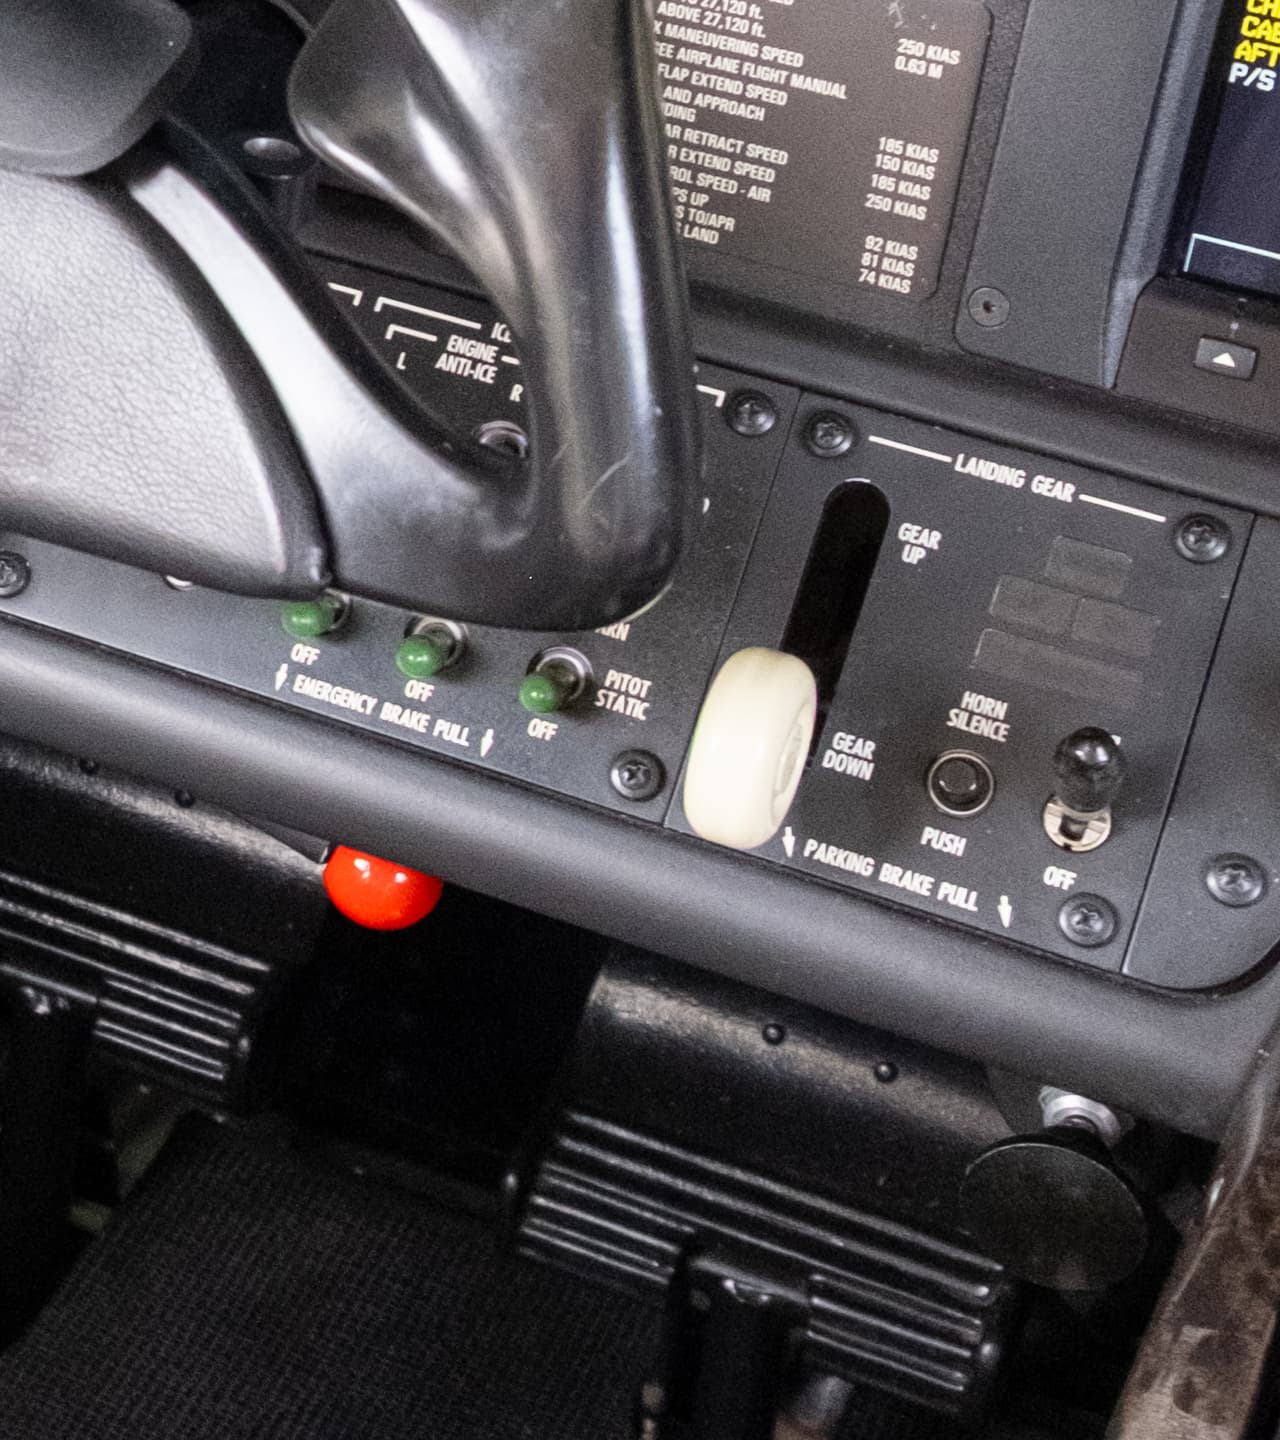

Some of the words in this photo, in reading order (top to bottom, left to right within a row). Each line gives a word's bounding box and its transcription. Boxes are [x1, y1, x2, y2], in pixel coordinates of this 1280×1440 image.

[657, 1, 701, 24] ABOVE
[897, 38, 924, 56] 250
[928, 46, 960, 64] KIAS
[895, 56, 926, 75] 0.63
[928, 64, 943, 79] M
[1227, 62, 1278, 93] P/S
[879, 137, 905, 155] 185
[907, 144, 939, 163] KIAS
[865, 235, 882, 251] 92
[885, 241, 918, 261] KIAS
[858, 269, 876, 284] 74
[878, 274, 911, 294] KIAS
[446, 334, 497, 364] ENGINE
[435, 353, 499, 384] ANTI-ICE
[954, 453, 1025, 491] LANDING
[1030, 475, 1076, 503] GEAR
[897, 522, 942, 551] GEAR
[902, 544, 927, 566] UP
[290, 643, 320, 666] OFF
[604, 669, 652, 699] PITOT
[293, 675, 377, 716] EMERGENCY
[380, 701, 428, 732] BRAKE
[432, 718, 470, 747] PULL
[596, 689, 651, 720] STATIC
[961, 690, 1009, 720] HORN
[946, 708, 1011, 743] SILENCE
[831, 731, 877, 760] GEAR
[822, 750, 875, 782] DOWN
[920, 825, 967, 857] PUSH
[803, 839, 875, 877] PARKING
[878, 863, 933, 897] BRAKE
[937, 882, 979, 912] PULL
[1043, 865, 1078, 891] OFF
